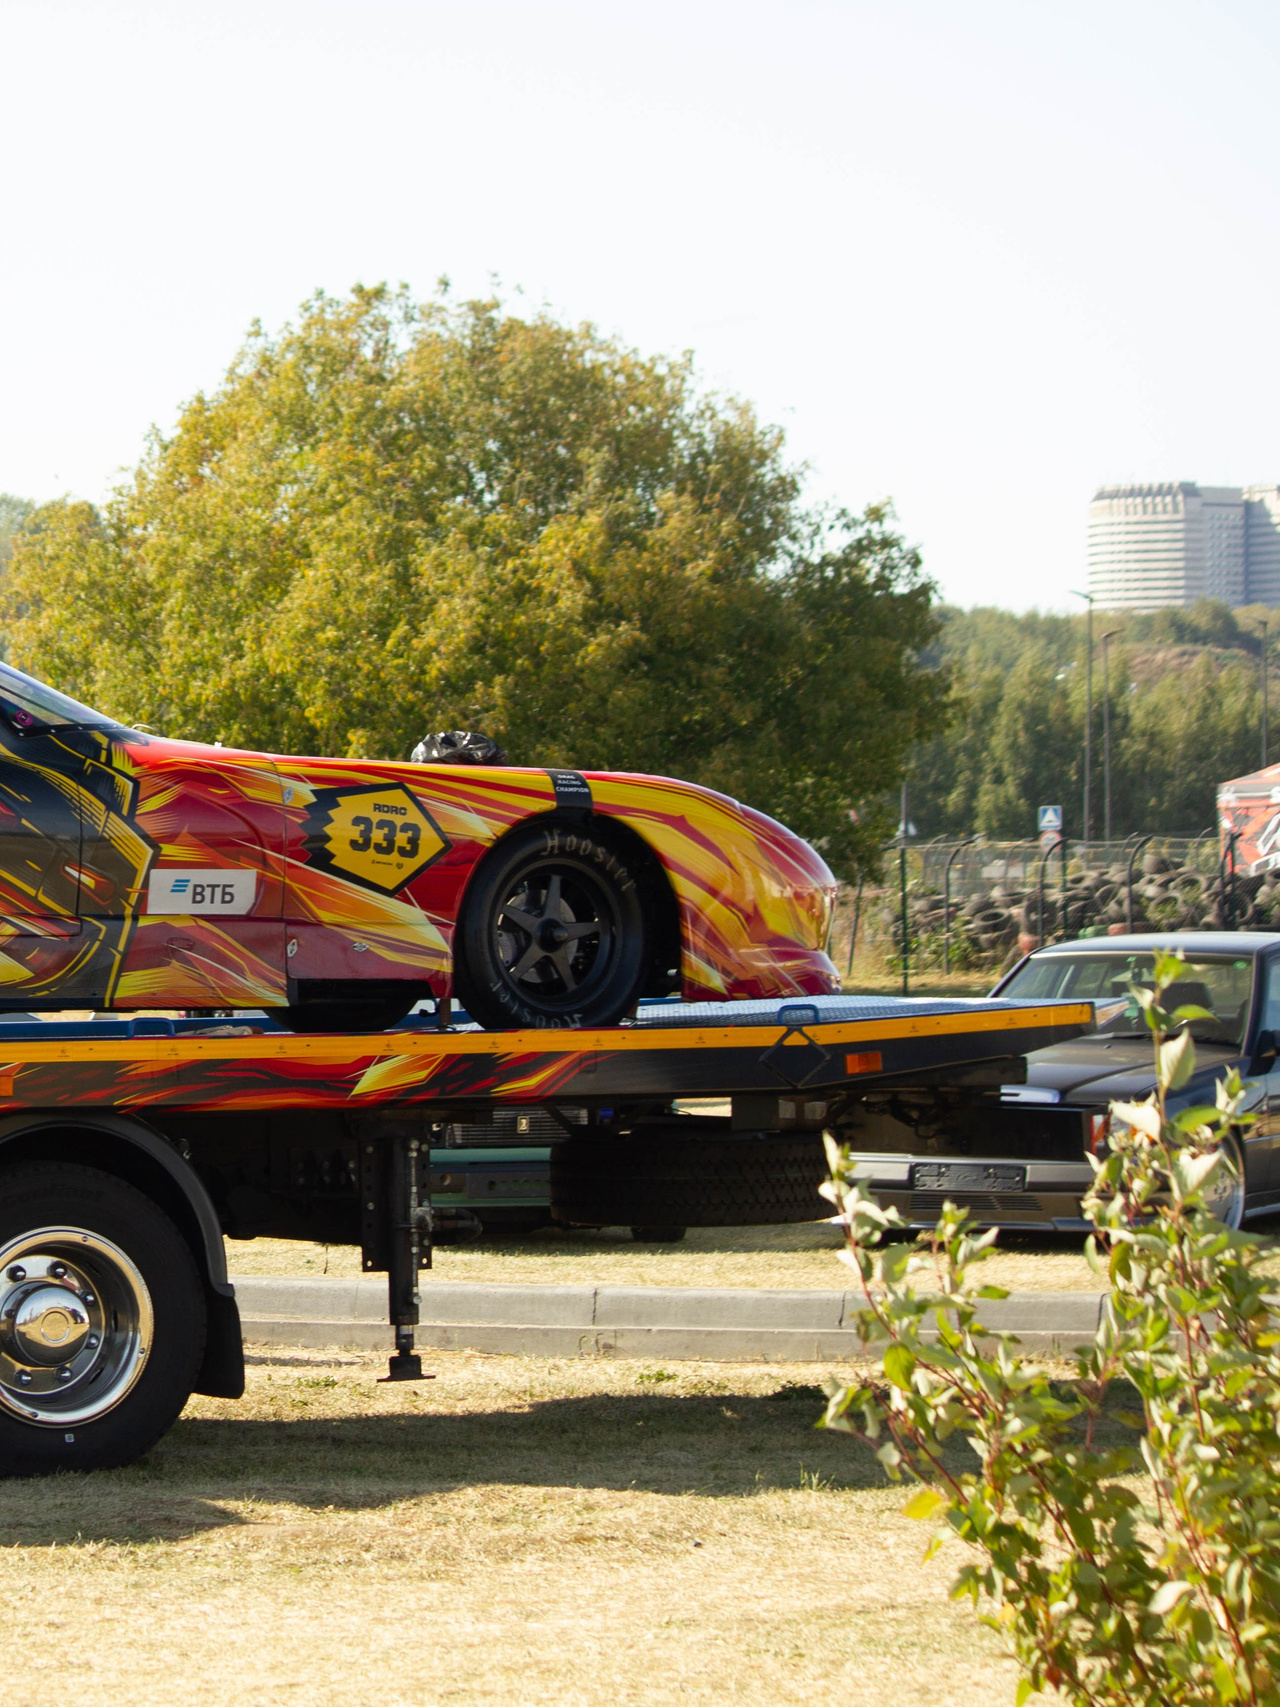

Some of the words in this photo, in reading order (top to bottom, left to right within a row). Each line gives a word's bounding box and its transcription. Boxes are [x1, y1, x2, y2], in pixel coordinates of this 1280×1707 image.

[373, 803, 407, 816] RDRC
[349, 815, 421, 859] 333
[191, 883, 235, 905] ВТБ
